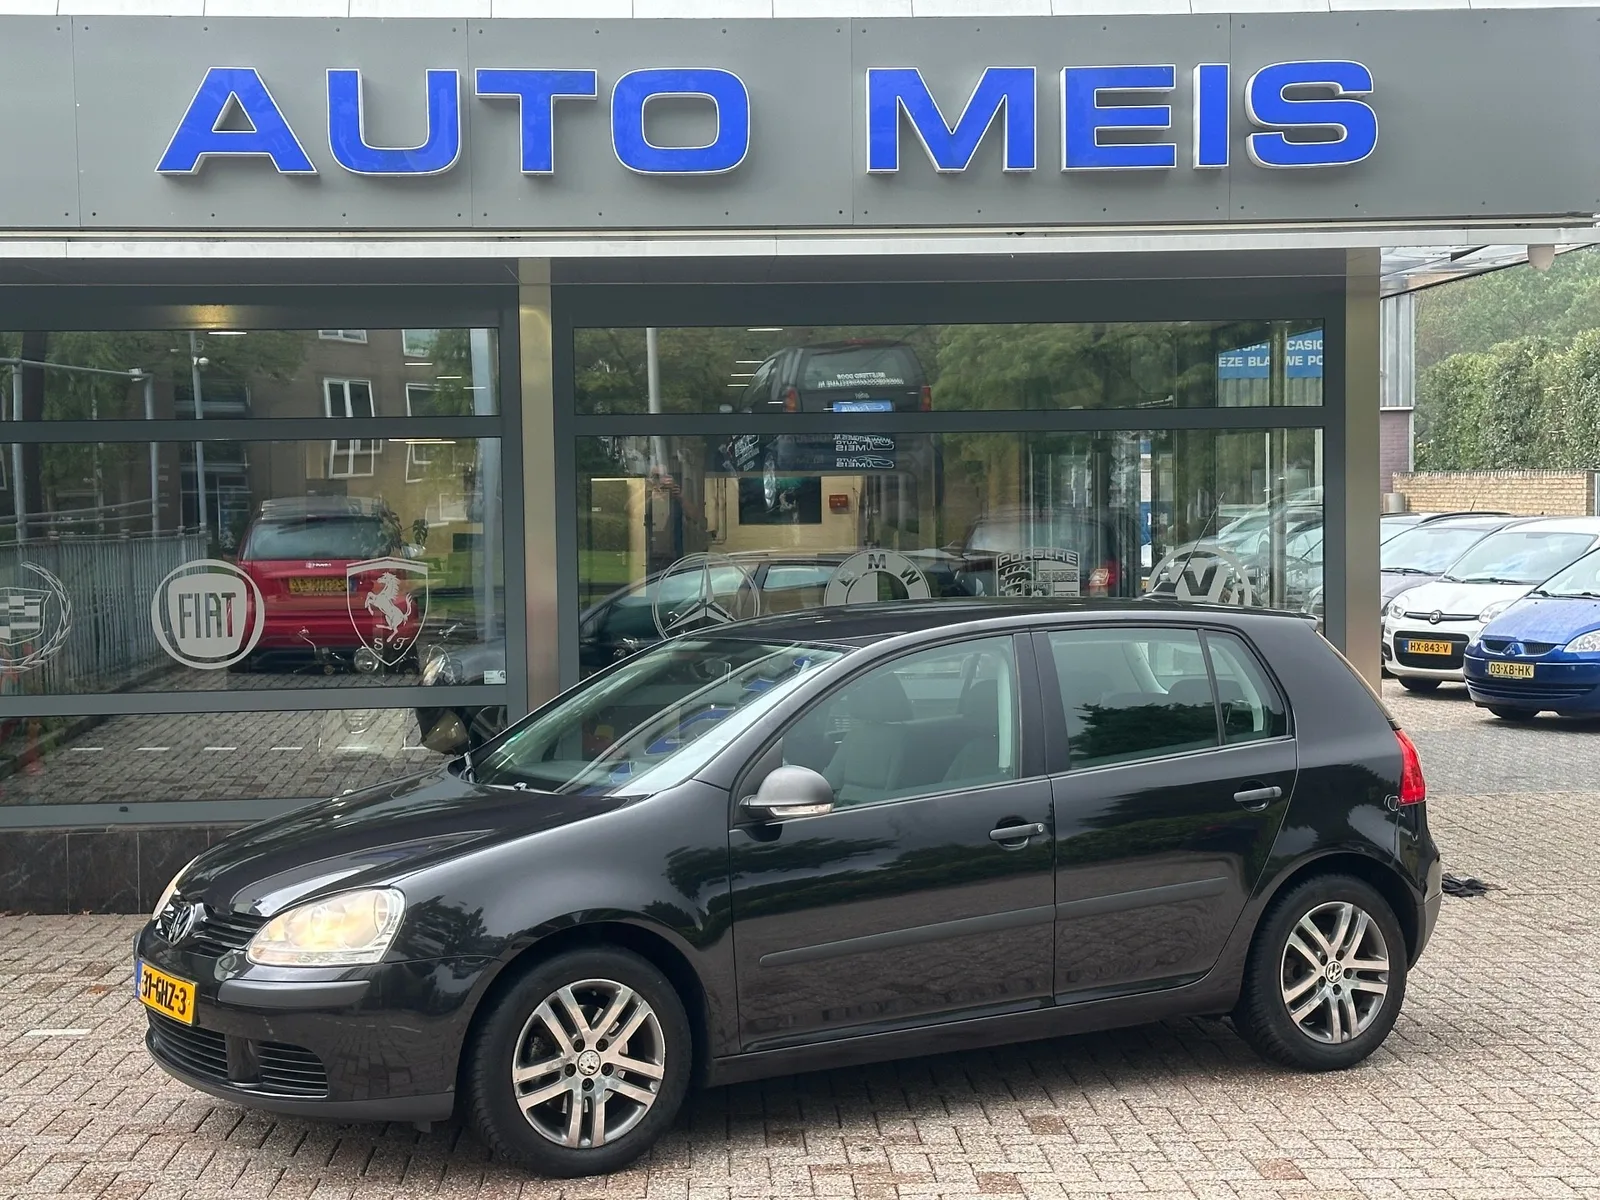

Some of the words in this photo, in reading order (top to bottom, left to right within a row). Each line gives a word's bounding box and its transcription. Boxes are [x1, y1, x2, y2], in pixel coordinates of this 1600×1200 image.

[155, 66, 752, 177] AUTO
[865, 59, 1379, 175] MEIS
[1218, 356, 1243, 367] EZE
[999, 549, 1077, 567] PORSCHE
[178, 591, 237, 639] FIAT
[1409, 641, 1449, 654] HX-843-V
[1490, 662, 1532, 676] 03-XB-HK
